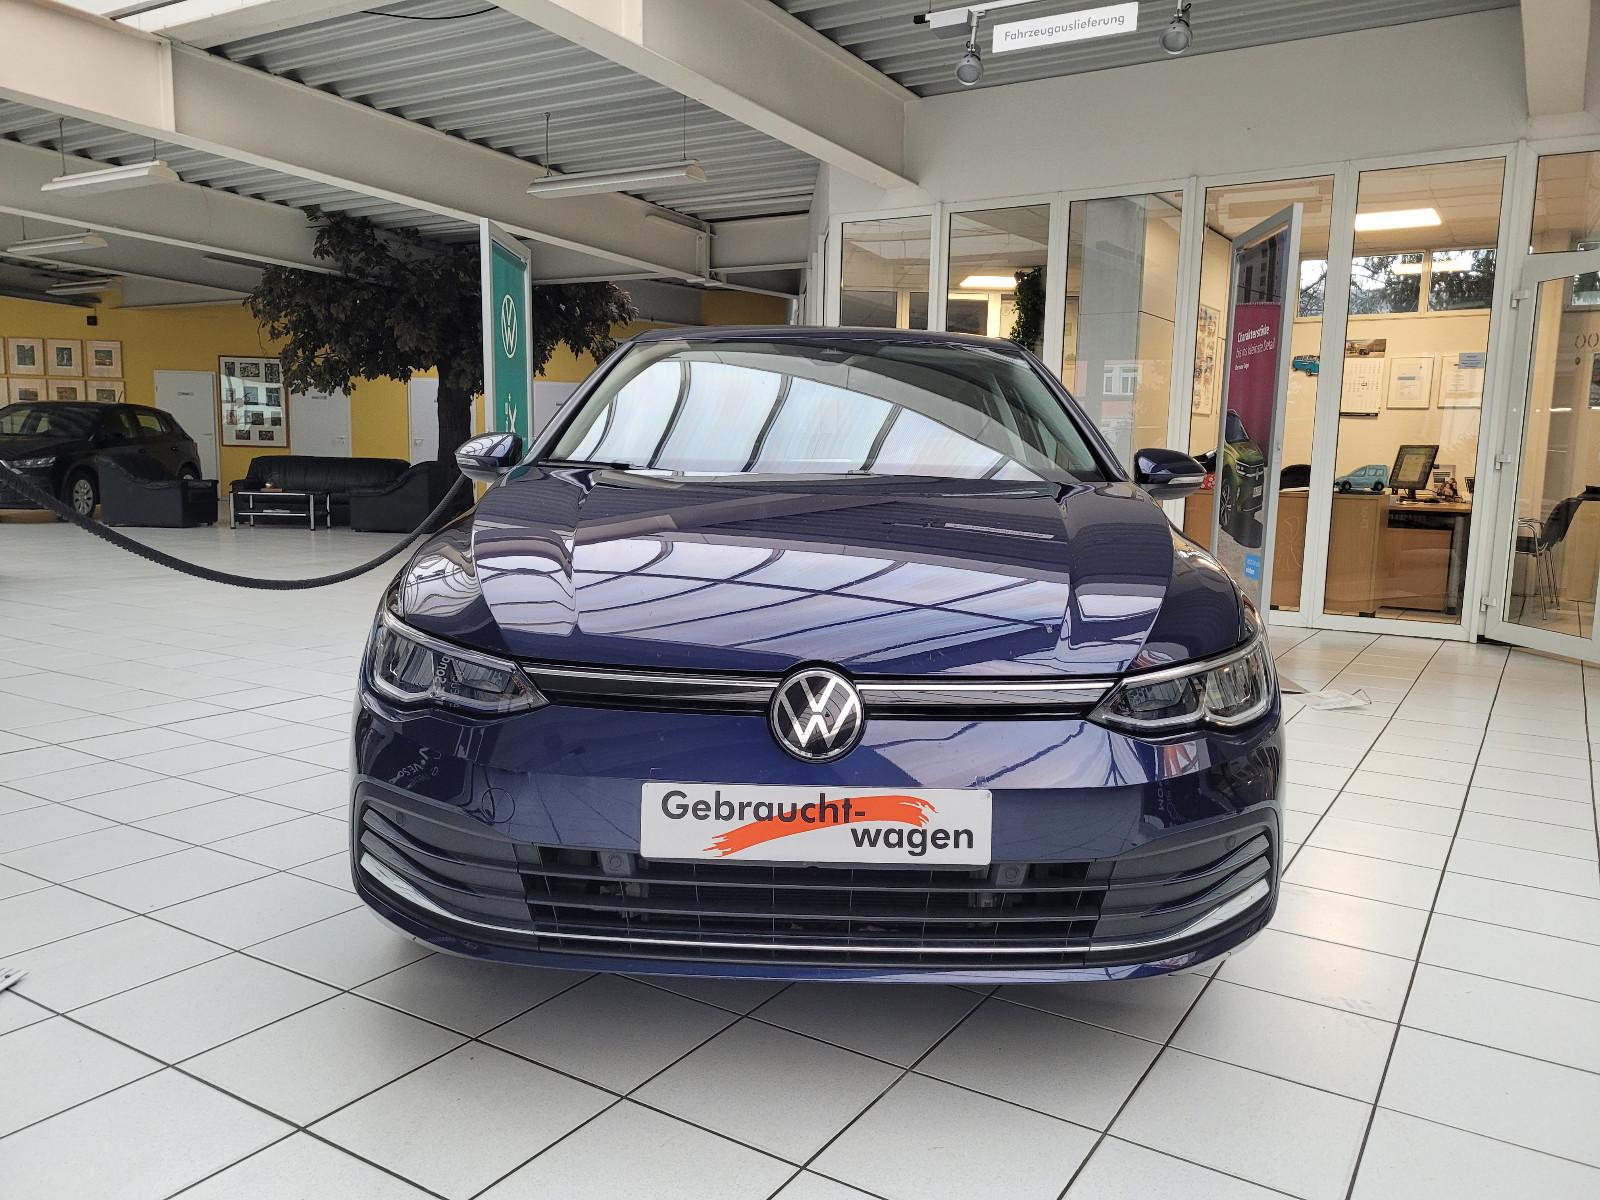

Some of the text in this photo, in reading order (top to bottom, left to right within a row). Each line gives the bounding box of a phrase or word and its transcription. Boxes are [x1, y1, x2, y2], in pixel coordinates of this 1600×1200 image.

[1004, 15, 1125, 41] Fahrzeugauslieferung
[661, 790, 866, 824] Gebraucht-
[850, 828, 974, 857] wagen
